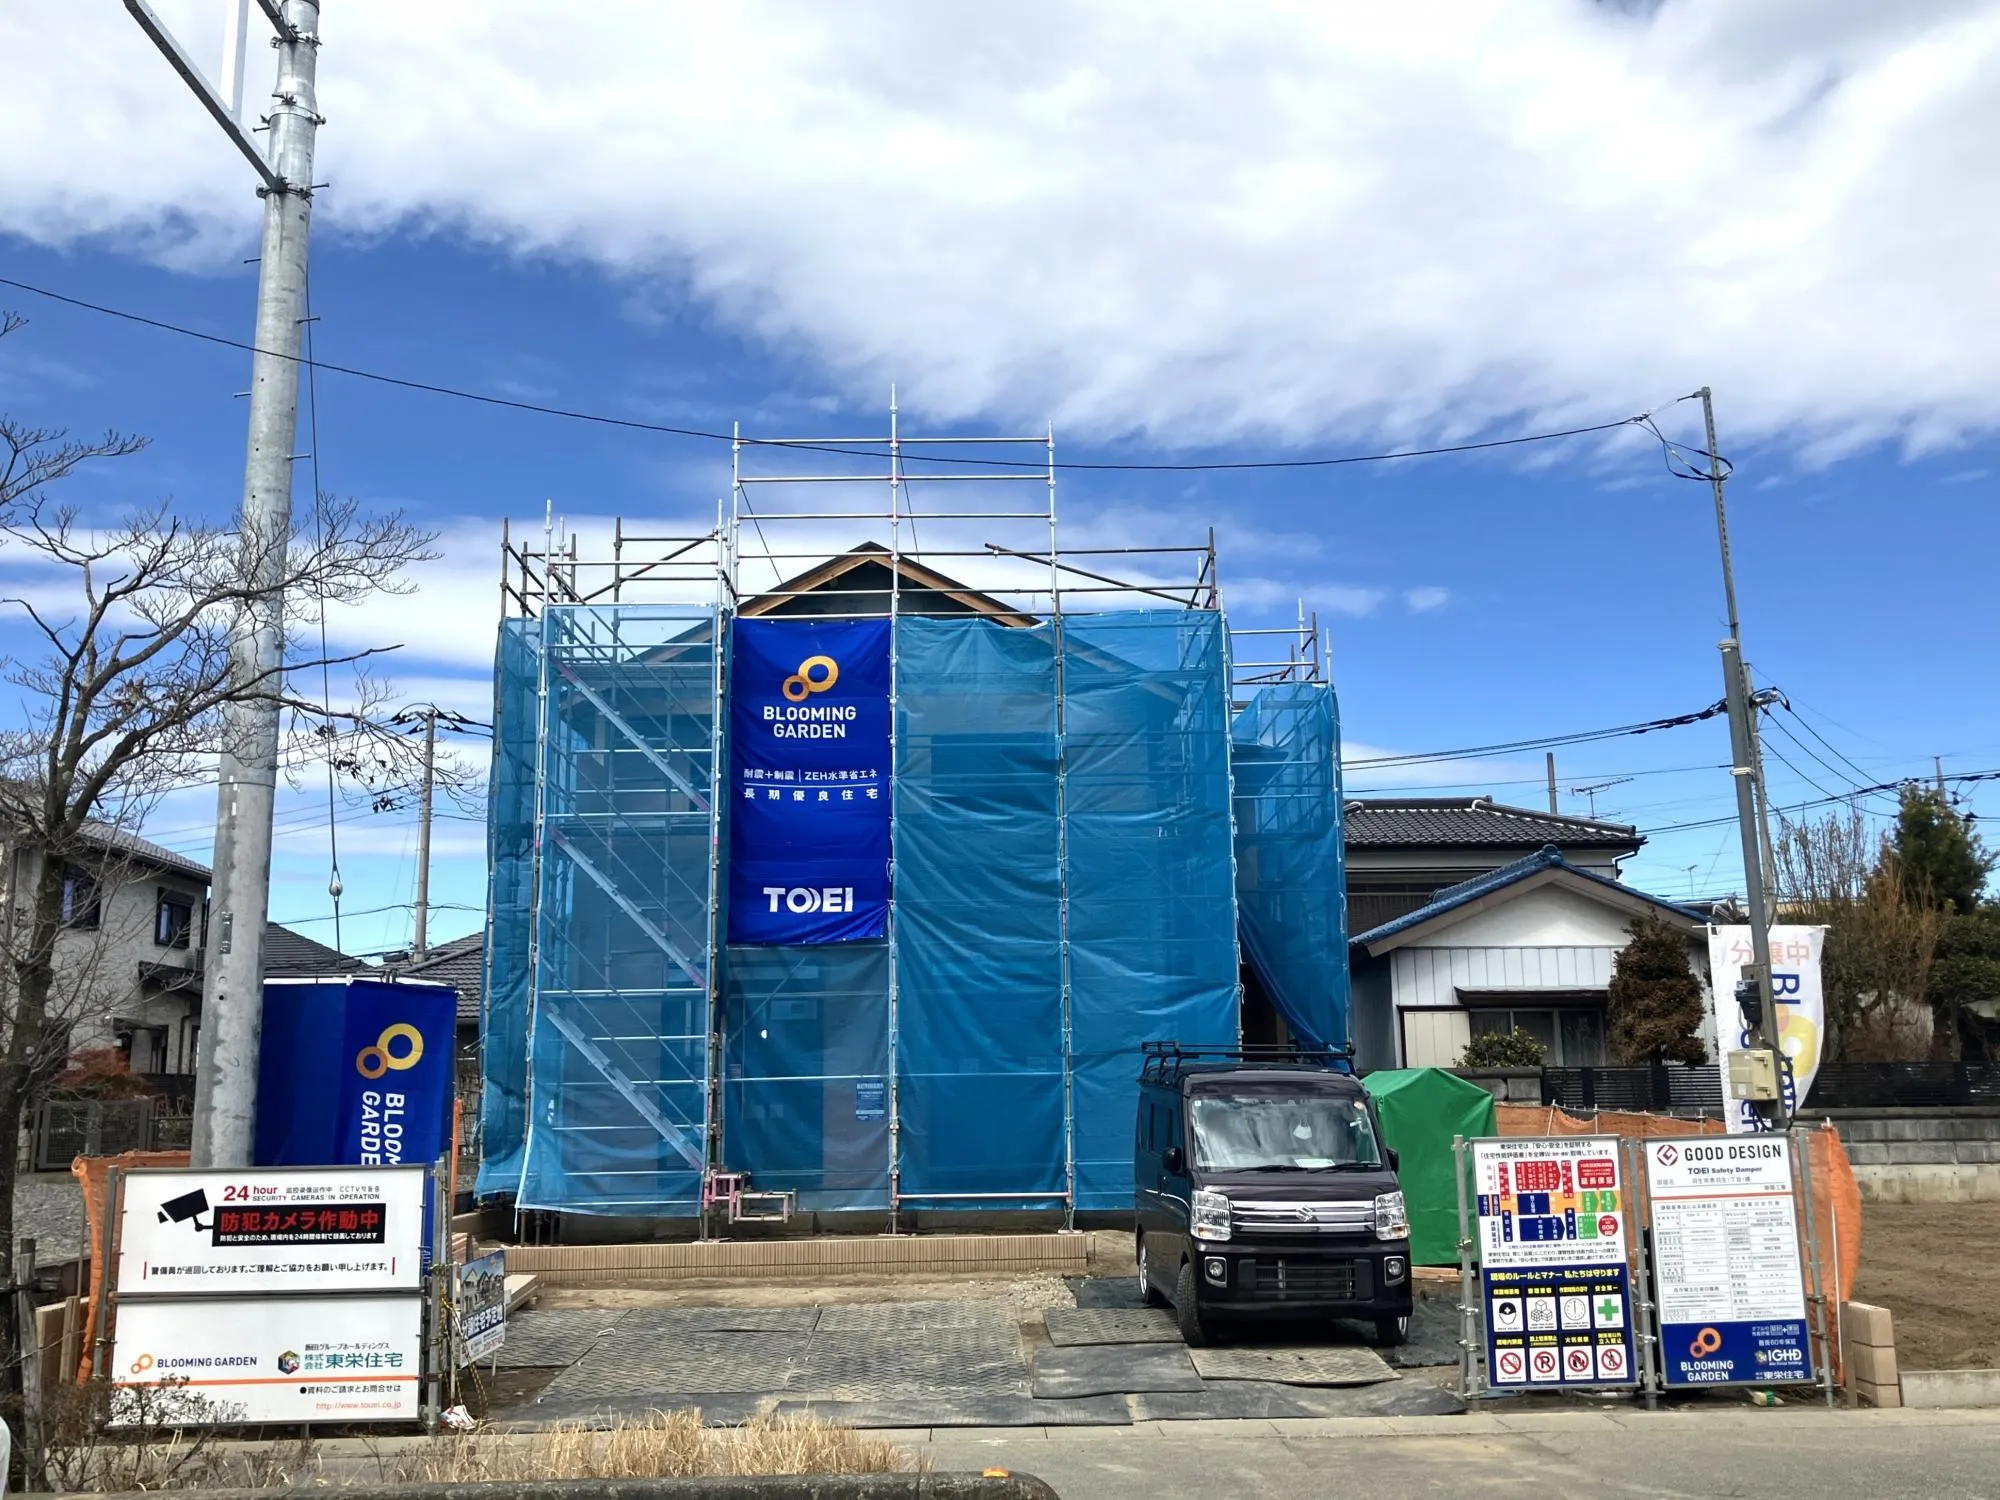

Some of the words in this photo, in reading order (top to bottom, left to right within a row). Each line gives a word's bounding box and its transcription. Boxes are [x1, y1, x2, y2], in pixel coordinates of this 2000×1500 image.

[763, 705, 857, 721] BLOOMING
[773, 723, 846, 738] GARDEN
[804, 768, 877, 781] ZEH水準省エネ
[743, 787, 878, 801] 長期優良住宅
[1684, 1146, 1724, 1161] GOOD
[1729, 1145, 1782, 1159] DESIGN
[223, 1185, 249, 1201] 24
[253, 1186, 278, 1194] hour
[220, 1209, 379, 1232] 防犯カメラ作動中
[151, 1261, 388, 1276] 警備員が巡回しております。ご理解とご協力をお願い申し上げます。
[1490, 1272, 1562, 1281] 現場のルールとマナー
[1564, 1268, 1620, 1279] 私たちは守ります
[304, 1342, 390, 1351] 飯田グループホールディングス
[304, 1353, 323, 1361] 株式
[304, 1361, 323, 1370] 会社
[325, 1352, 403, 1369] 東栄住宅
[1767, 1348, 1802, 1361] IGHD
[157, 1357, 211, 1369] BLOOMING
[214, 1356, 258, 1367] GARDEN
[1680, 1360, 1734, 1371] BLOOMING
[1687, 1371, 1729, 1382] GARDEN
[1763, 1370, 1804, 1380] 東栄住宅
